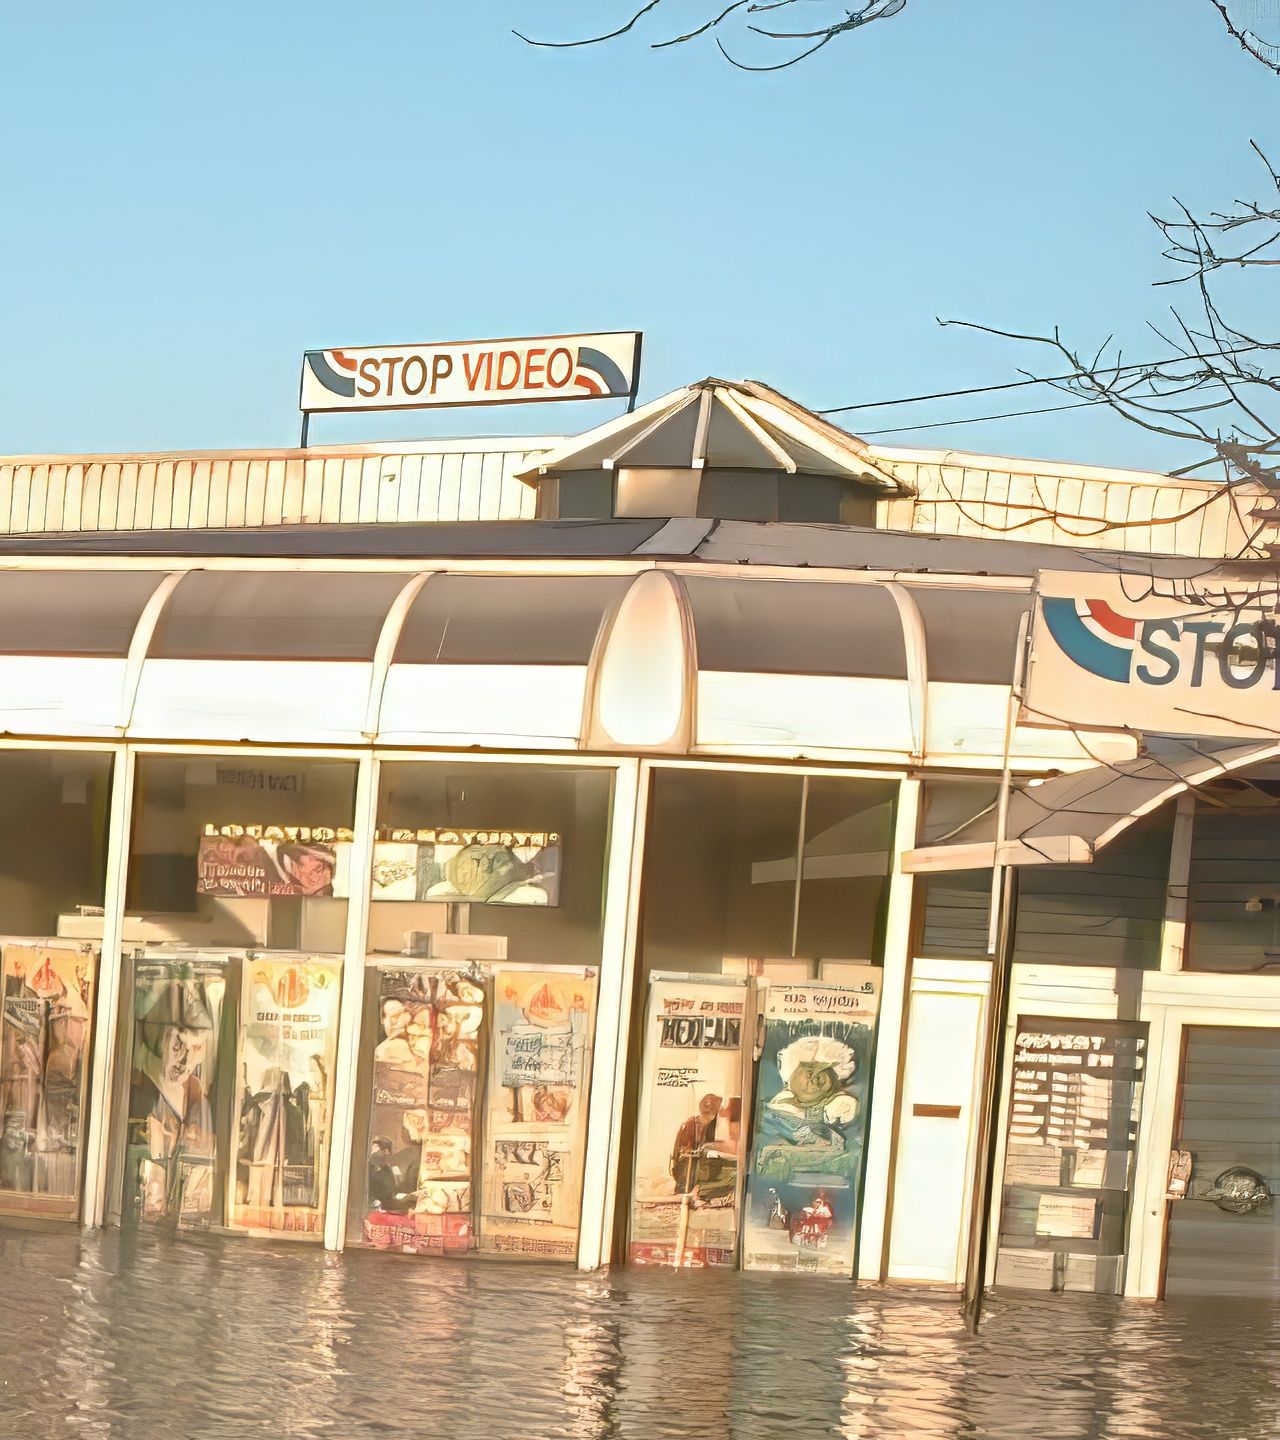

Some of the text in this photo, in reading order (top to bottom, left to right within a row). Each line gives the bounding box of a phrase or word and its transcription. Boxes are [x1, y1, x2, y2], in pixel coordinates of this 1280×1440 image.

[356, 347, 573, 398] STOP VIDEO
[1136, 619, 1280, 691] STO
